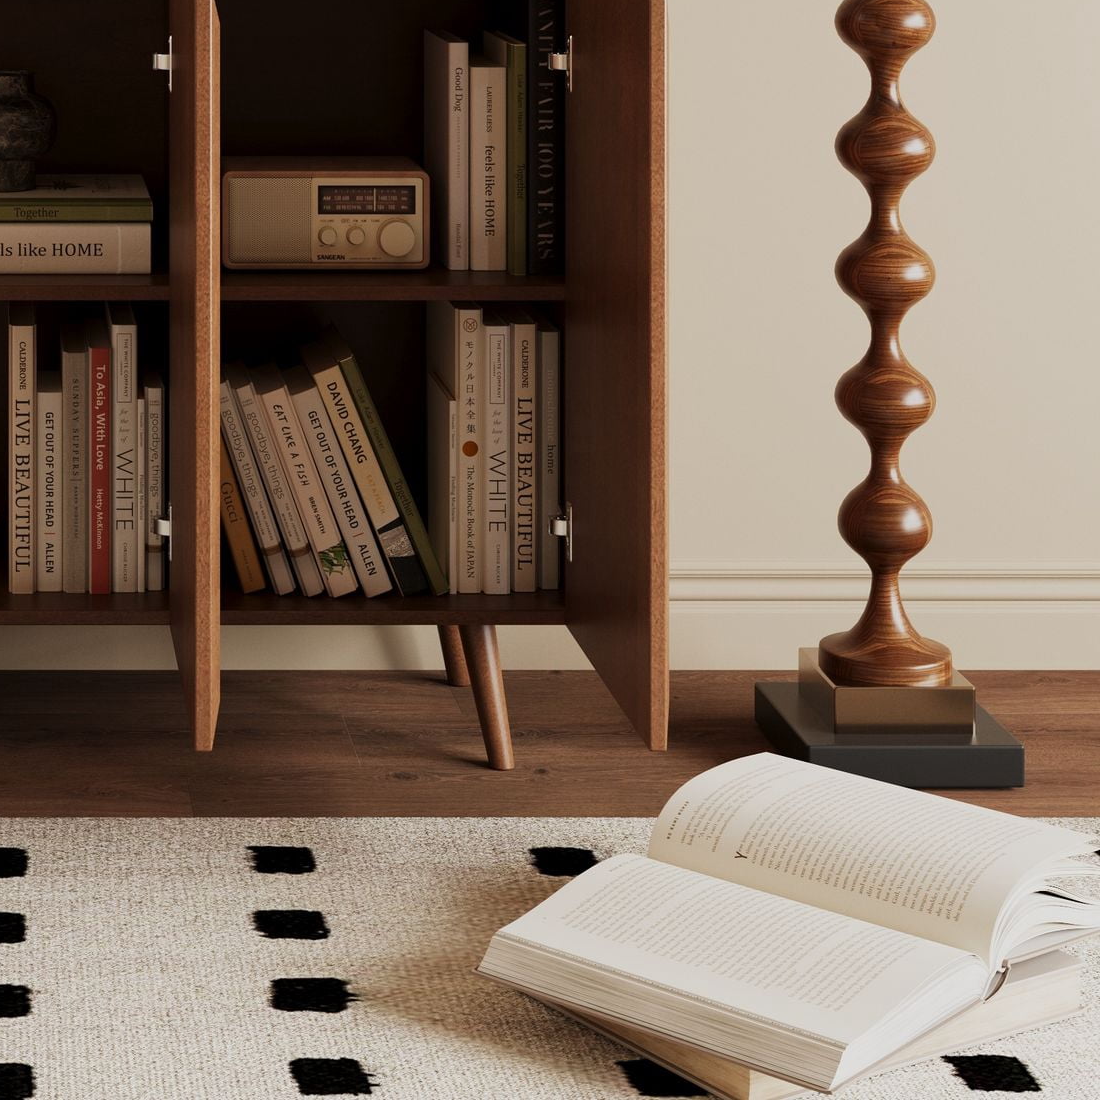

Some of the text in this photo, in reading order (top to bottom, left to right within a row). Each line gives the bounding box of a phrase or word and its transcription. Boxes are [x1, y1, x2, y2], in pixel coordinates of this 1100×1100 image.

[454, 94, 463, 112] Dog
[455, 67, 463, 91] Good
[485, 86, 493, 133] LAUREN LIESS
[538, 82, 554, 131] FAIR
[13, 208, 59, 219] Together
[484, 144, 495, 237] feels like HOME
[537, 186, 554, 260] YEARS
[19, 243, 47, 257] like
[52, 243, 103, 257] HOME
[95, 365, 106, 470] To Asia, With Love
[150, 413, 160, 462] goodbye,
[223, 409, 258, 498] goodbye, things
[273, 405, 288, 423] EAT
[282, 427, 296, 448] LIKE
[294, 464, 310, 486] FISH
[327, 382, 367, 464] DAVID CHANG
[15, 400, 31, 573] LIVE BEAUTIFUL
[46, 412, 54, 527] GET OUT OF YOUR HEAD
[116, 449, 134, 530] WHITE
[150, 465, 160, 497] things
[247, 412, 284, 500] goodbye, things
[308, 411, 359, 529] GET OUT OF YOUR HEAD
[489, 450, 507, 532] WHITE
[516, 398, 533, 571] LIVE BEAUTIFUL
[547, 445, 556, 475] home
[220, 482, 242, 523] Gucci
[309, 497, 326, 534] BREN SMITH
[466, 466, 475, 578] The Monocle Book of JAPAN
[46, 543, 54, 573] ALLEN
[358, 545, 377, 576] ALLEN
